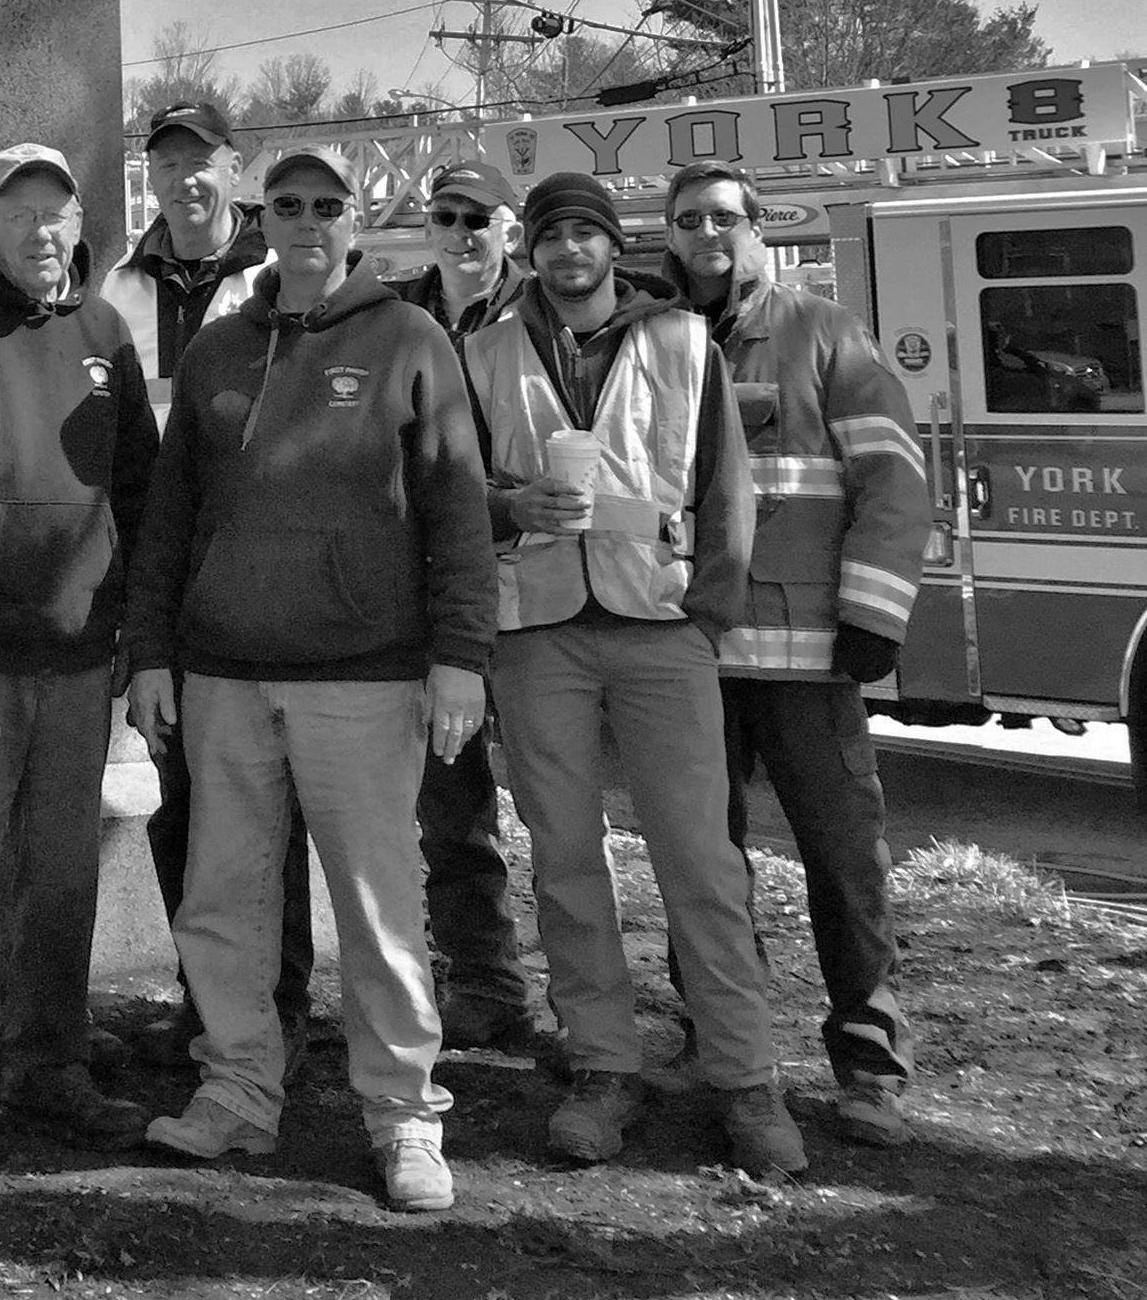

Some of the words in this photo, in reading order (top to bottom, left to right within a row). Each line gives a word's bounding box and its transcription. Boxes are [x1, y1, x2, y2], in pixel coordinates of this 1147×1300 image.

[563, 86, 981, 175] YORK
[1006, 78, 1086, 124] 8
[1008, 125, 1088, 142] TRUCK
[759, 207, 799, 221] Pierce
[1014, 466, 1127, 494] YORK
[1008, 507, 1062, 526] FIRE
[1072, 509, 1140, 530] DEPT.
